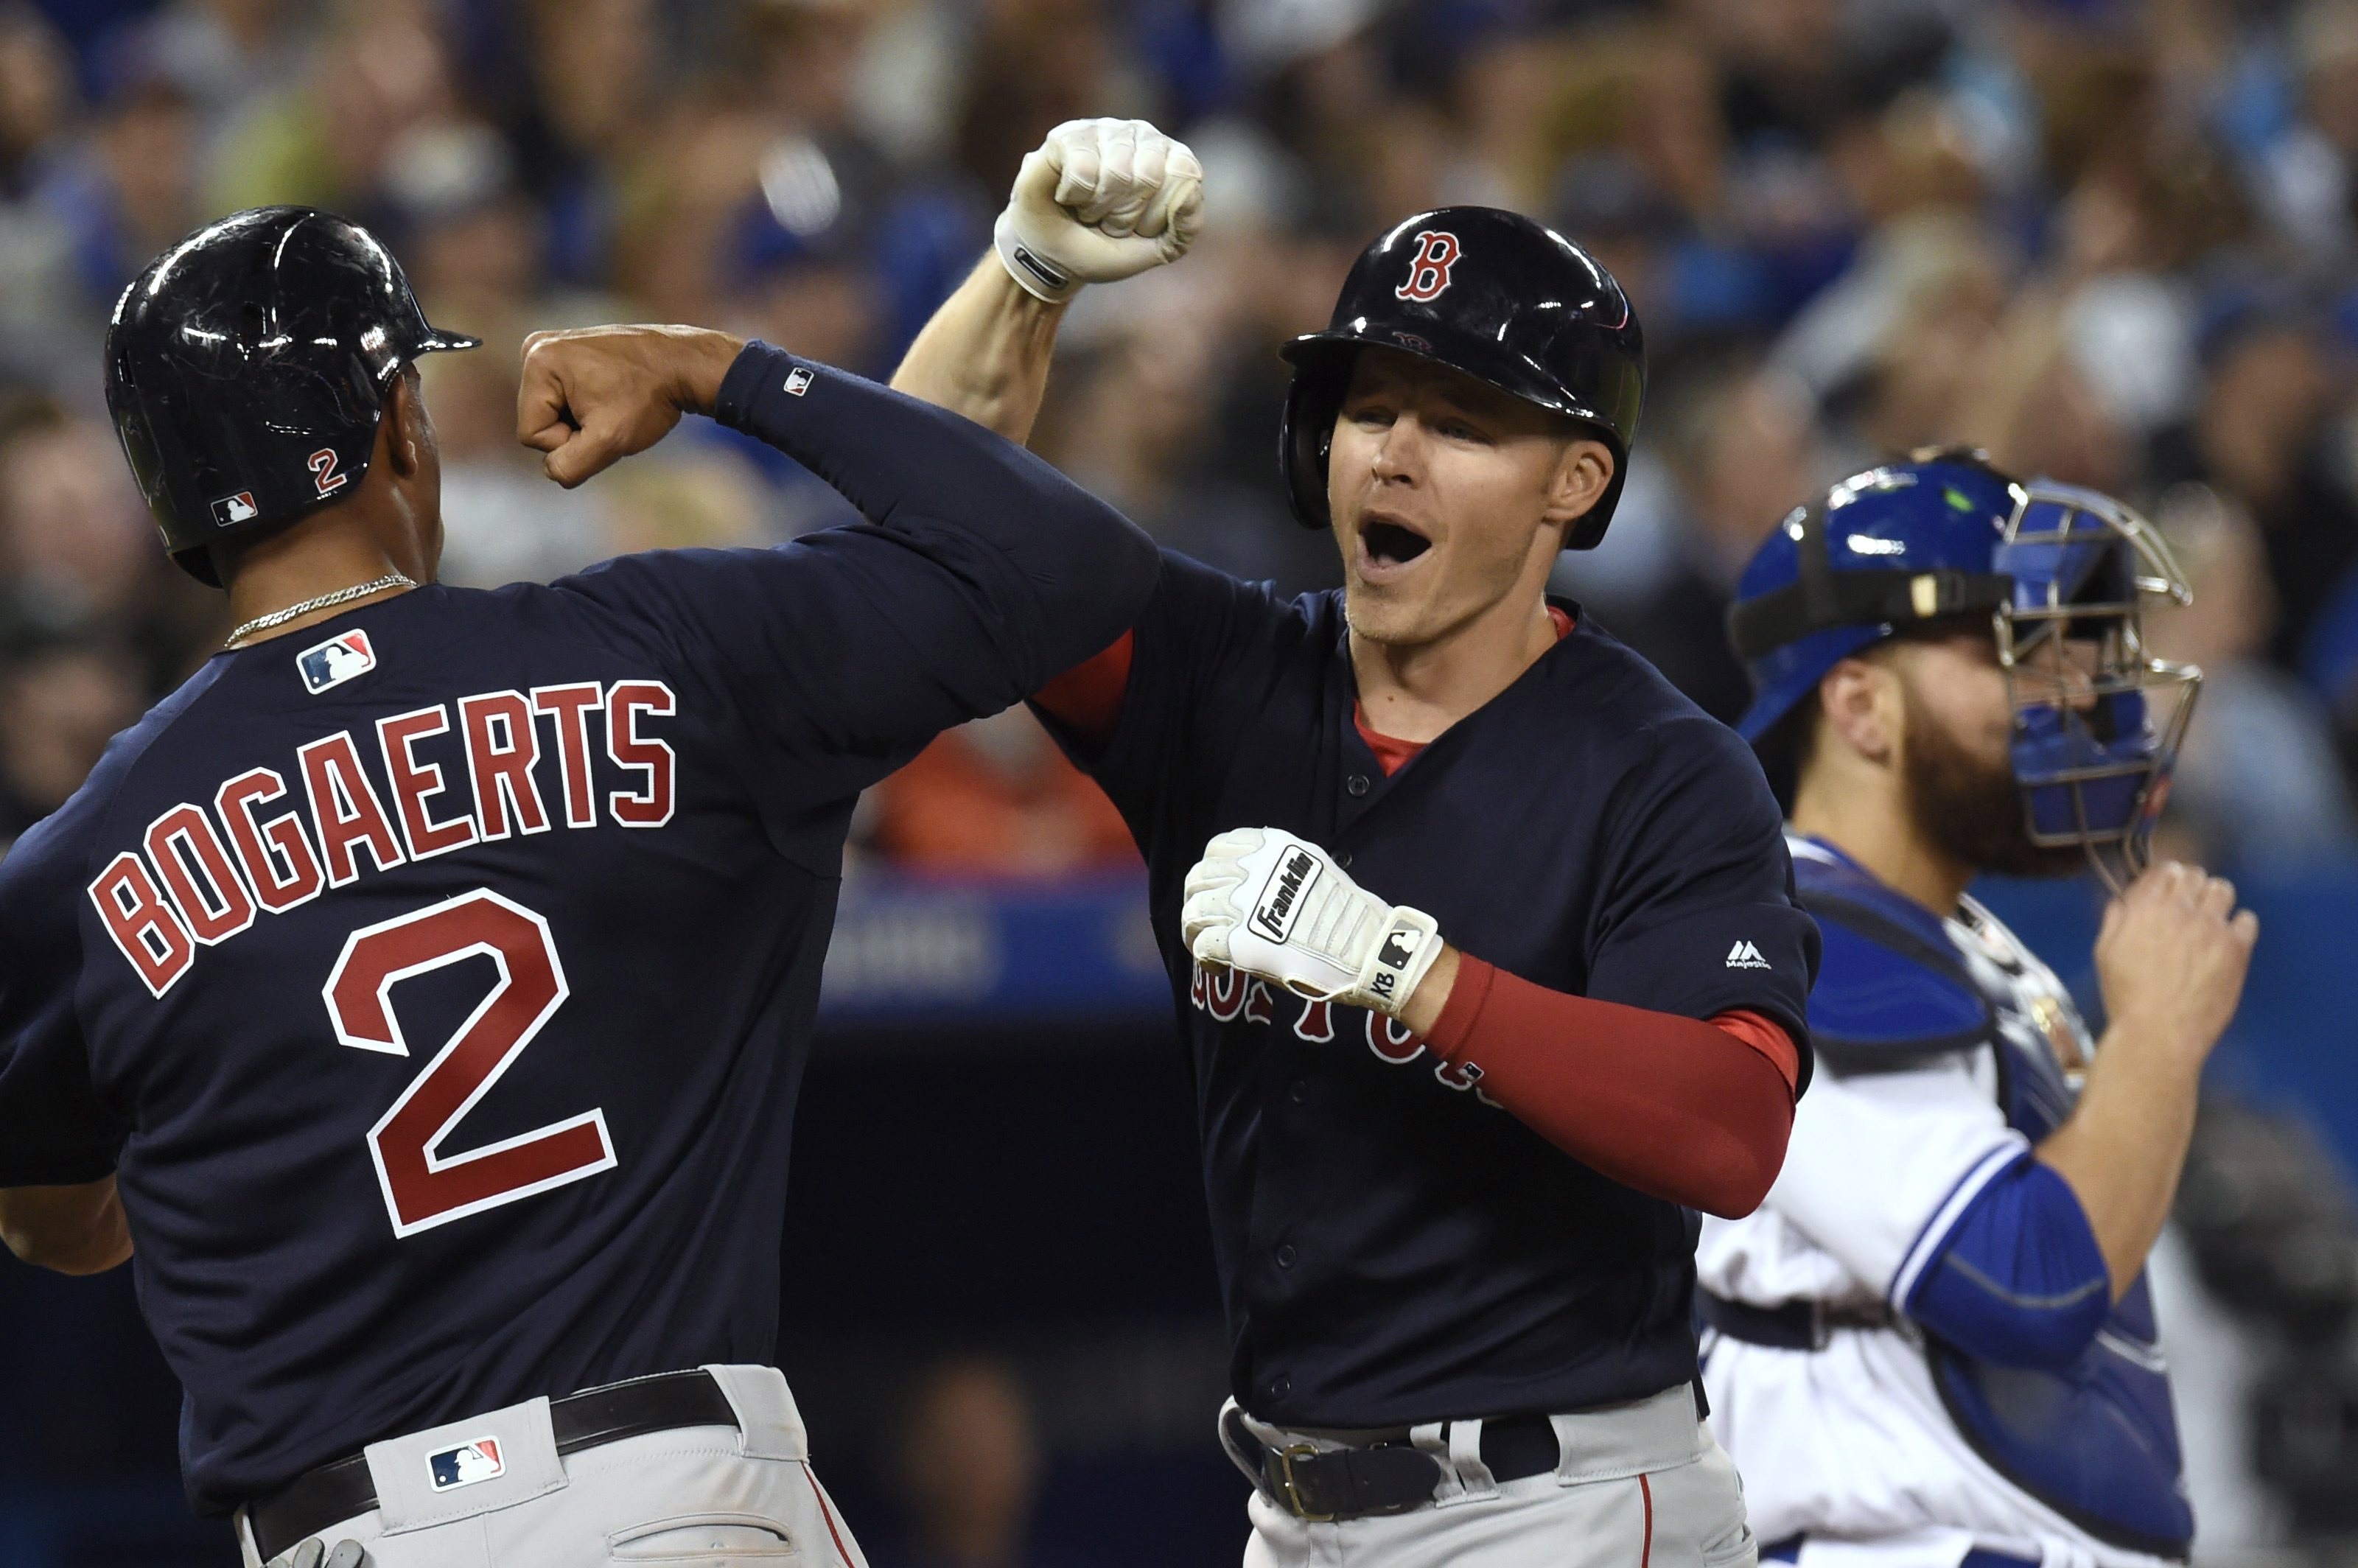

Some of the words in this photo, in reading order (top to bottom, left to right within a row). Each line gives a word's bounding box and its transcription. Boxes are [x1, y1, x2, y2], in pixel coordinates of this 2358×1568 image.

[1394, 230, 1463, 302] B
[307, 447, 348, 494] 2
[87, 679, 676, 1000] BOGAERTS
[1256, 852, 1314, 939] Franklin
[1370, 971, 1395, 998] KB
[322, 887, 618, 1239] 2
